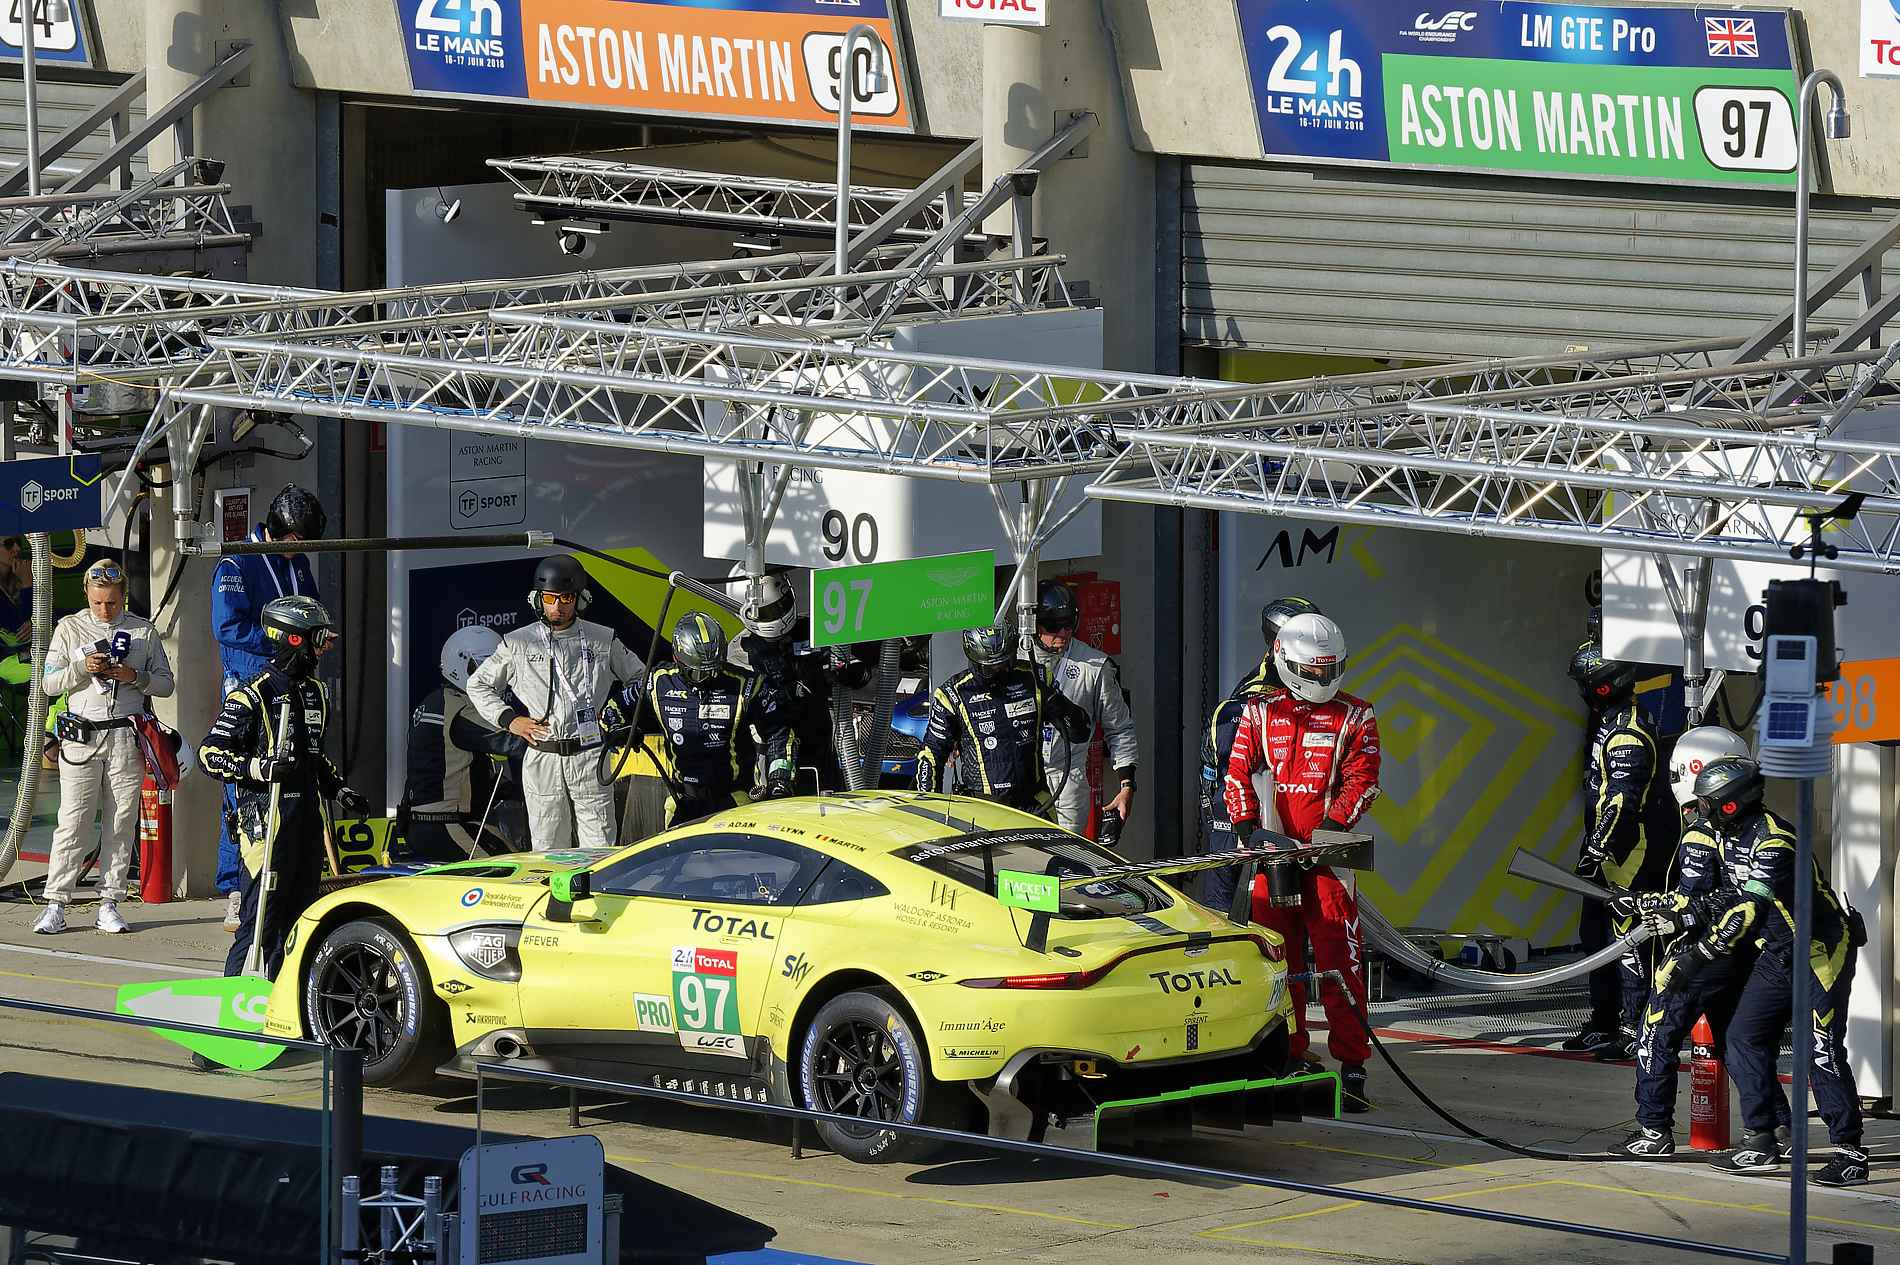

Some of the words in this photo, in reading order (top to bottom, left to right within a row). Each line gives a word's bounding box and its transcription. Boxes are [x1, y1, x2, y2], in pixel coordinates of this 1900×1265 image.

[1415, 11, 1477, 31] WEC
[1520, 13, 1553, 48] LM
[1561, 16, 1604, 51] GTE
[1613, 19, 1656, 53] Pro
[416, 33, 440, 52] LE
[444, 36, 504, 57] MANS
[445, 54, 465, 65] 16-17
[487, 58, 505, 69] 2018
[537, 23, 648, 91] ASTON
[661, 33, 796, 102] MARTIN
[1266, 24, 1362, 98] 24h
[1267, 96, 1293, 114] LE
[1298, 98, 1364, 120] MANS
[1299, 117, 1321, 129] 16-17
[1324, 119, 1342, 130] JUIN
[1344, 120, 1364, 131] 2018
[1400, 84, 1522, 152] ASTON
[1533, 90, 1685, 160] MARTIN
[1721, 99, 1772, 159] 97
[459, 446, 484, 456] ASTON
[486, 442, 518, 454] MARTIN
[473, 455, 503, 467] RACING
[26, 491, 39, 502] TF
[44, 488, 79, 501] SPORT
[461, 499, 476, 511] TF
[480, 494, 518, 509] SPORT
[821, 508, 879, 565] 90
[1720, 519, 1770, 538] ARTIN
[823, 579, 873, 634] 97
[921, 598, 949, 609] ASTON
[480, 612, 517, 627] SPORT
[1743, 604, 1769, 661] 9
[1317, 655, 1337, 663] TOTAL
[664, 705, 687, 713] HACKETT
[1277, 783, 1318, 793] OTAL
[780, 826, 807, 836] LYNN
[828, 837, 867, 853] MARTIN
[1004, 878, 1052, 897] HACKETT
[691, 908, 775, 940] TOTAL
[894, 902, 936, 918] WALDORF
[936, 914, 972, 928] ASTORIA
[474, 935, 503, 947] TAG
[524, 935, 559, 947] #FEVER
[471, 949, 504, 964] HEUER
[696, 955, 735, 970] TOTAL
[915, 972, 940, 981] DOW
[1151, 968, 1241, 995] TOTAL
[443, 983, 466, 992] DOW
[404, 972, 417, 1030] MICHELIN
[680, 975, 730, 1031] 97
[637, 1000, 671, 1028] PRO
[698, 1036, 736, 1048] WEC
[958, 1048, 999, 1056] MICHELIN
[801, 1030, 816, 1103] MICHELIN
[899, 1041, 918, 1115] MICHELIN
[479, 1193, 518, 1208] GULF
[521, 1183, 586, 1203] RACING
